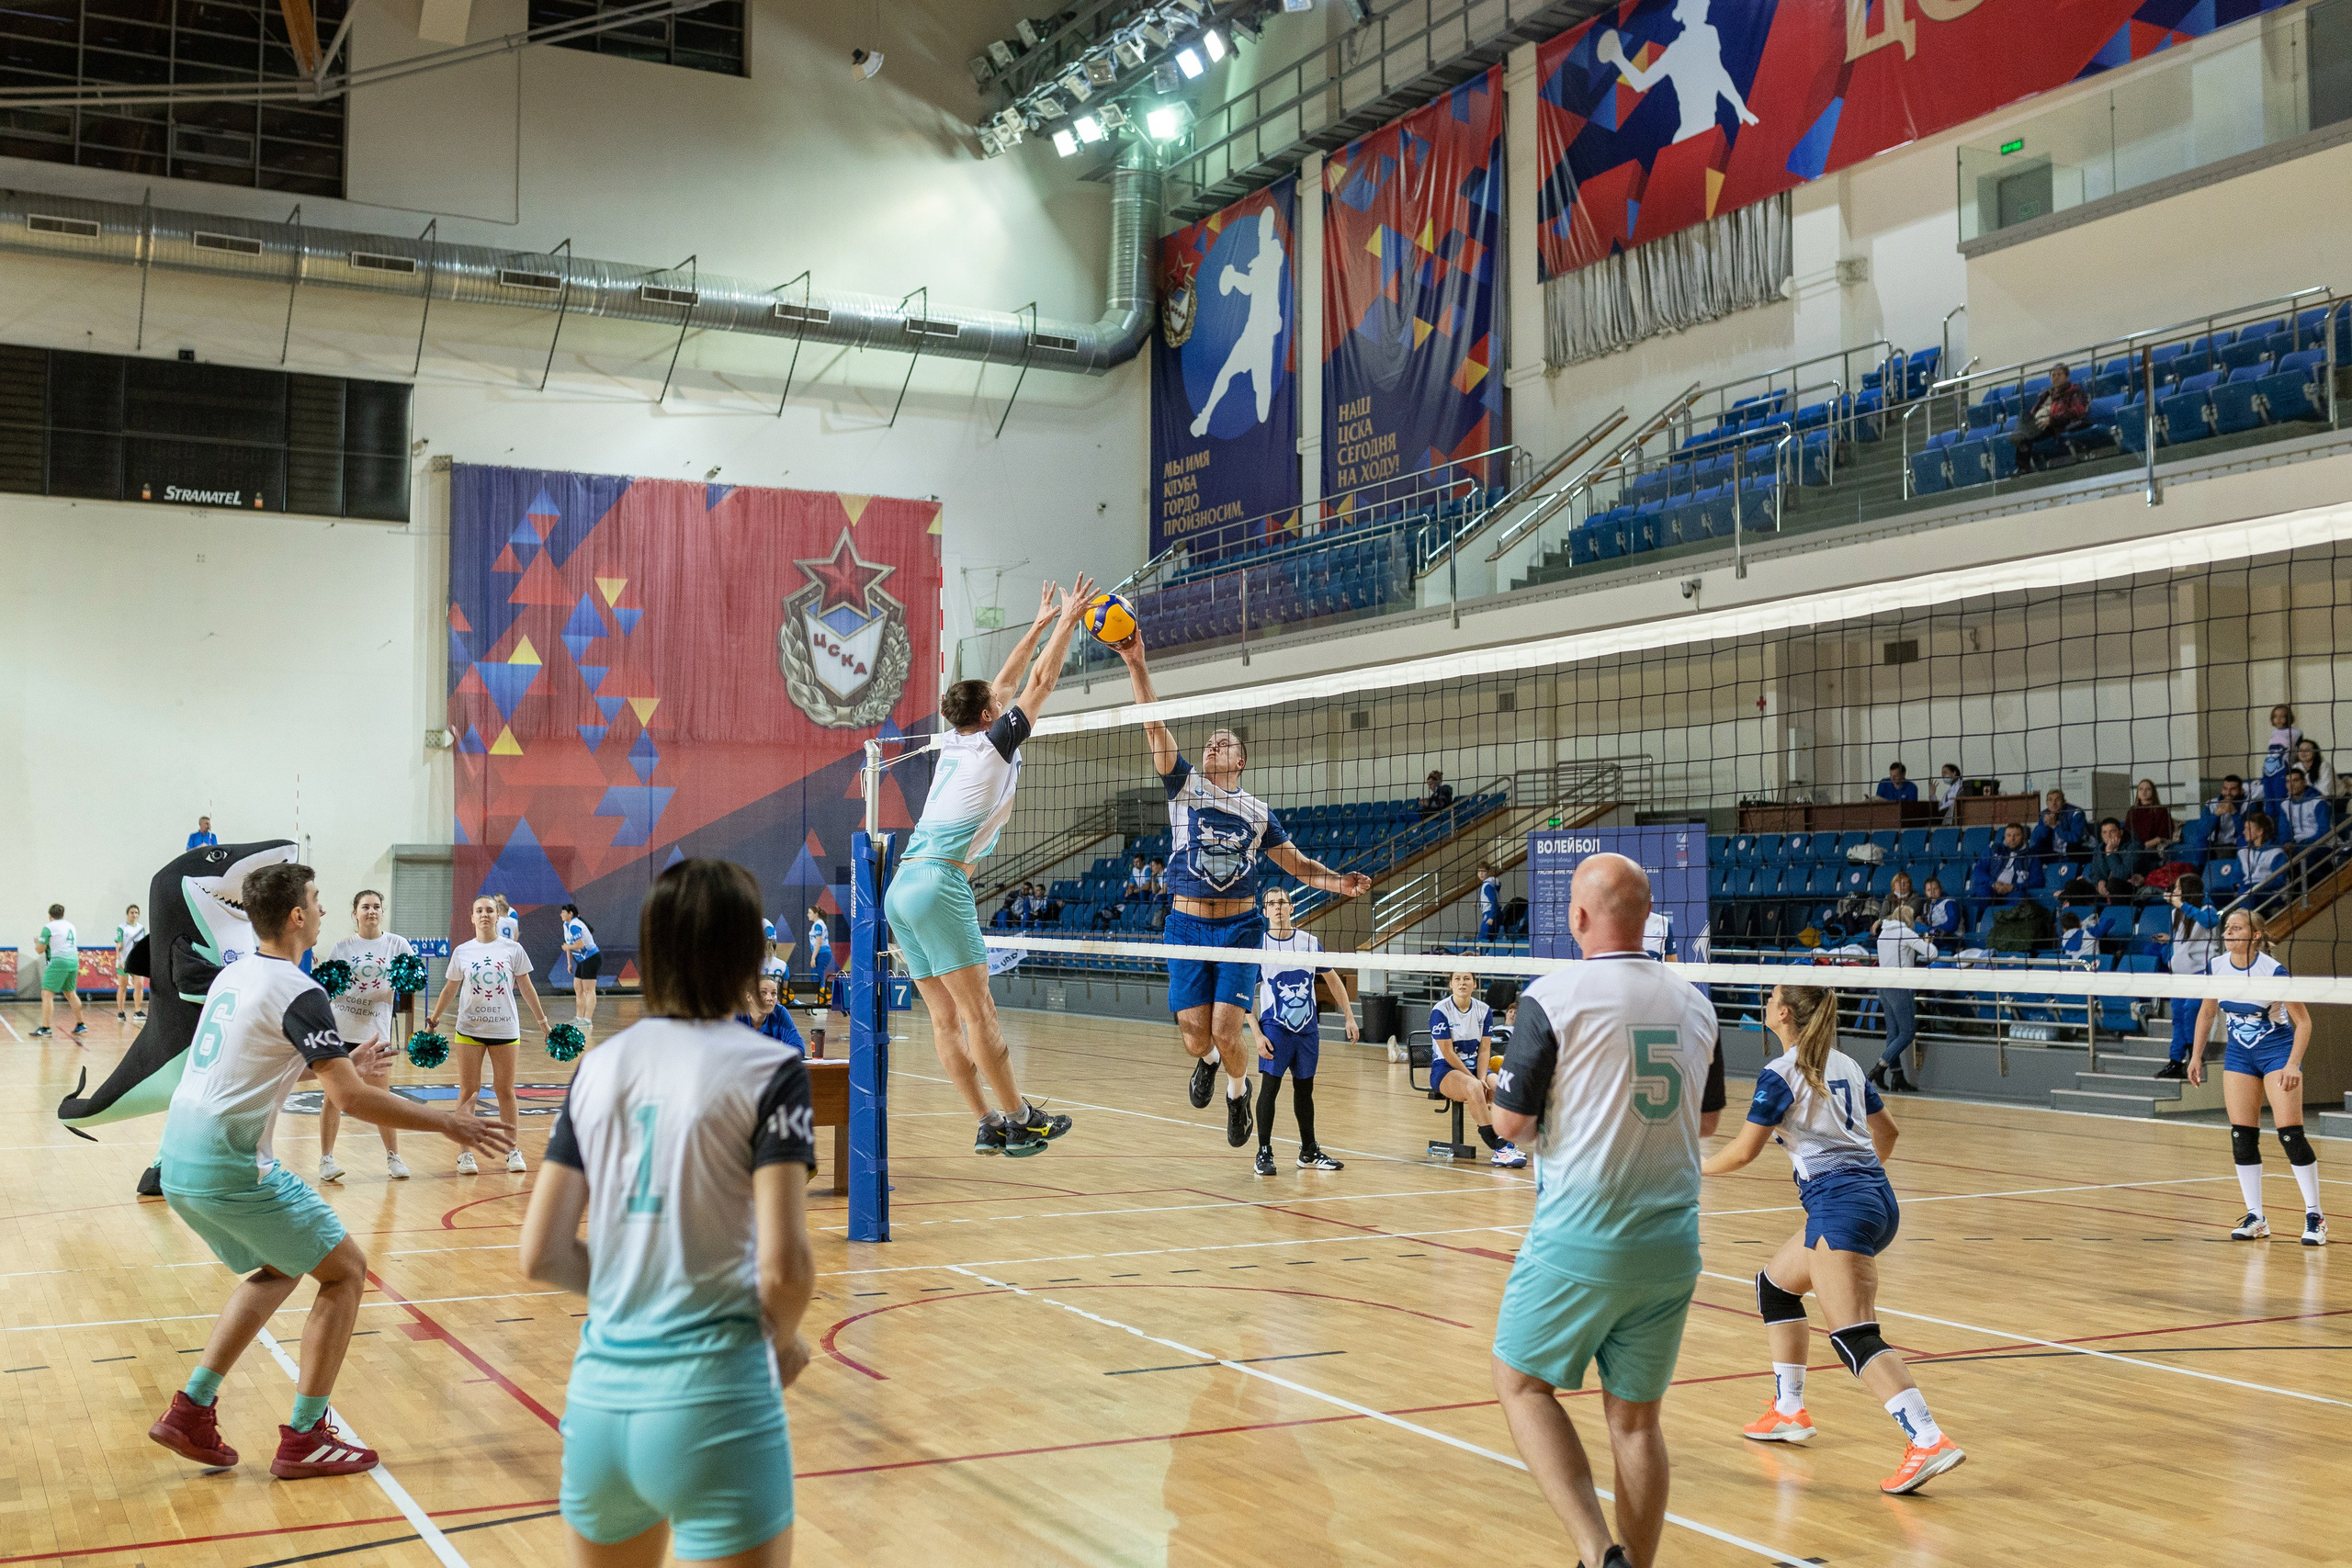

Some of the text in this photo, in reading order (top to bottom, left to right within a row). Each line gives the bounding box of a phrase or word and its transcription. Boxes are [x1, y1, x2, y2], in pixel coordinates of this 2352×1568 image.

[1339, 396, 1371, 423] НАШ
[1338, 418, 1374, 446] ЦСКА
[1338, 432, 1396, 466] СЕГОДНЯ
[1163, 449, 1210, 479] МЫ ИМЯ
[1338, 453, 1399, 488] НА ХОДУ!
[164, 485, 242, 506] STRAMATEL
[1163, 474, 1197, 498] КЛУБА
[1163, 492, 1200, 517] ГОРДО
[1163, 500, 1244, 536] ПРОИЗНОСИМ,
[813, 633, 867, 675] ЦСКА
[928, 757, 962, 803] 7
[1537, 837, 1600, 854] ВОЛЕЙБОЛ
[66, 928, 74, 945] 4
[438, 943, 448, 955] 4
[345, 996, 373, 1006] СОВЕТ
[895, 986, 907, 1006] 7
[190, 987, 240, 1074] 6
[468, 1015, 512, 1023] ОЛОДЕЖИ
[1626, 1023, 1684, 1125] 5
[1827, 1078, 1854, 1131] 7
[626, 1101, 666, 1216] 1
